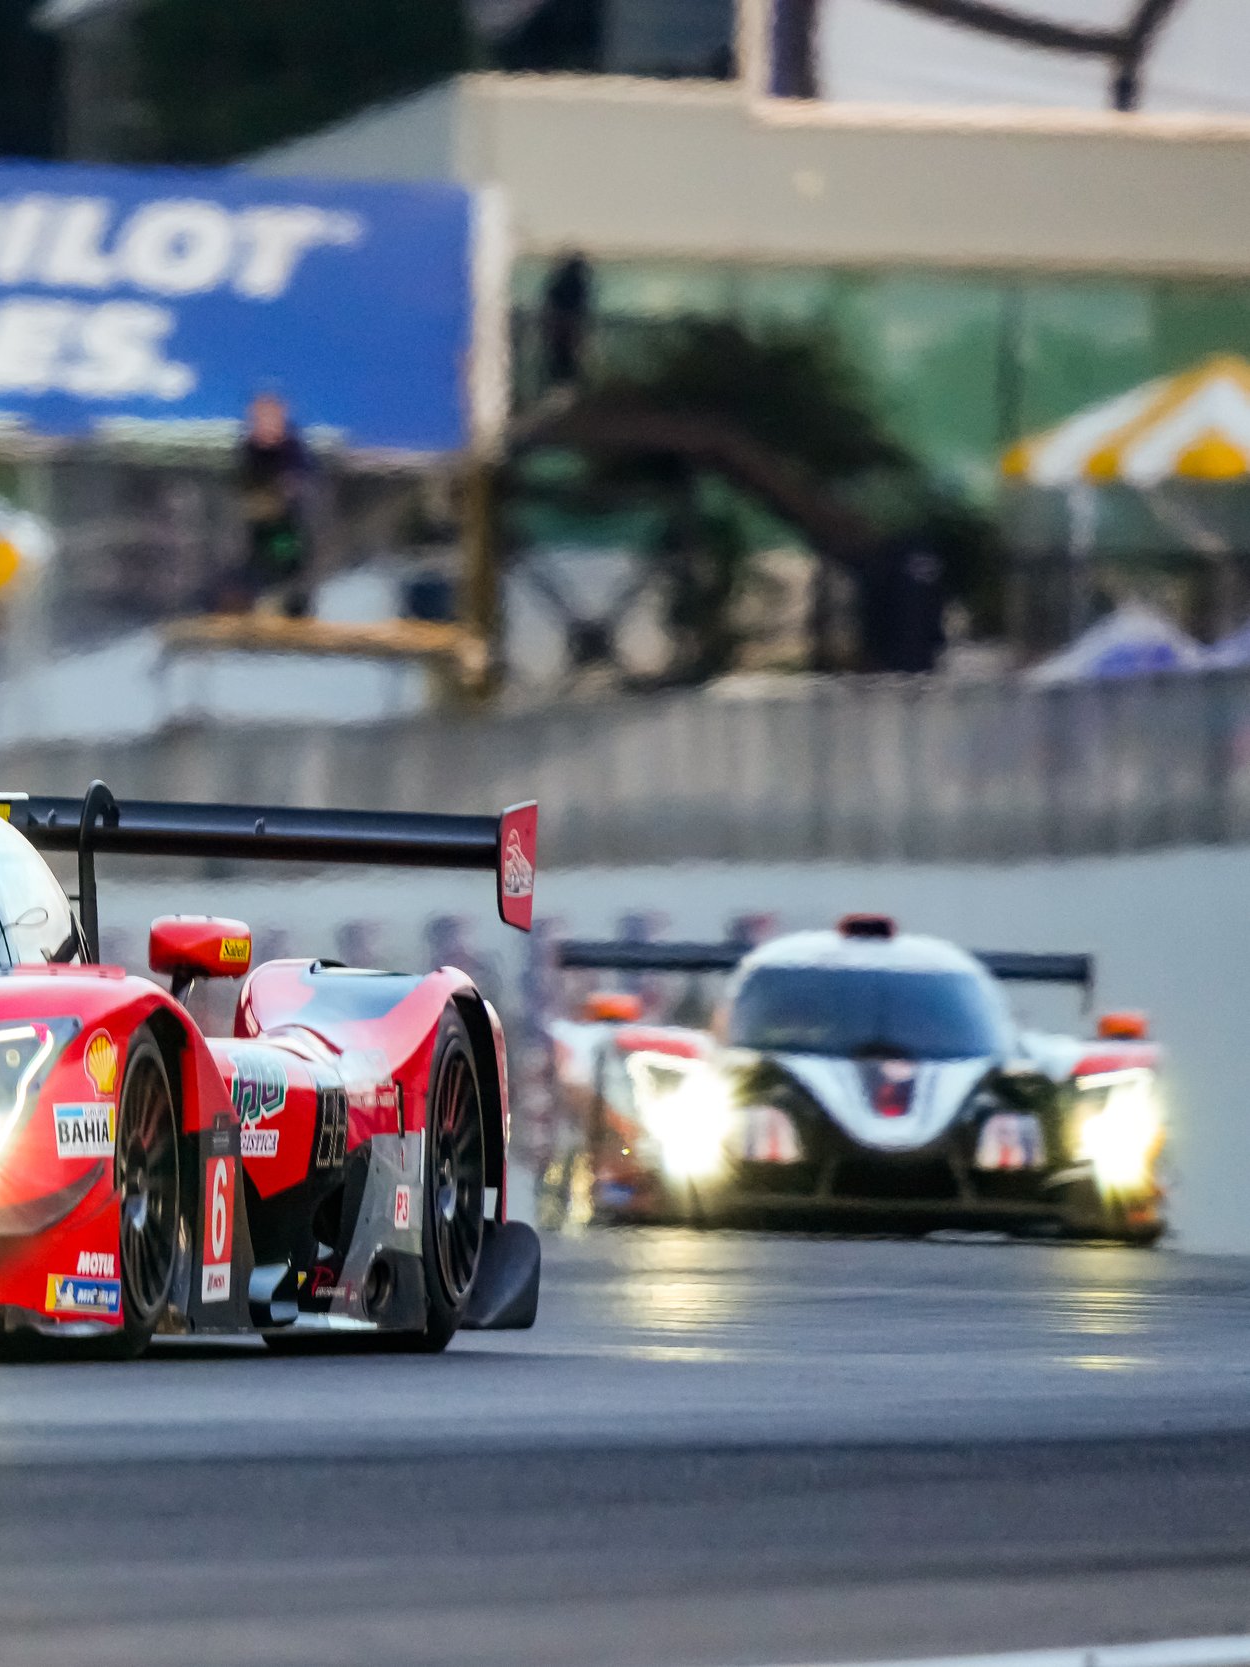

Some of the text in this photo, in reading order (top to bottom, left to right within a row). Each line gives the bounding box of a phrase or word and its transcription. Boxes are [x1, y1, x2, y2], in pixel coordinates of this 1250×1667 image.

[58, 1120, 109, 1144] BAHIA
[211, 1158, 227, 1260] 6
[396, 1191, 409, 1221] P3
[76, 1251, 114, 1277] MOTUL
